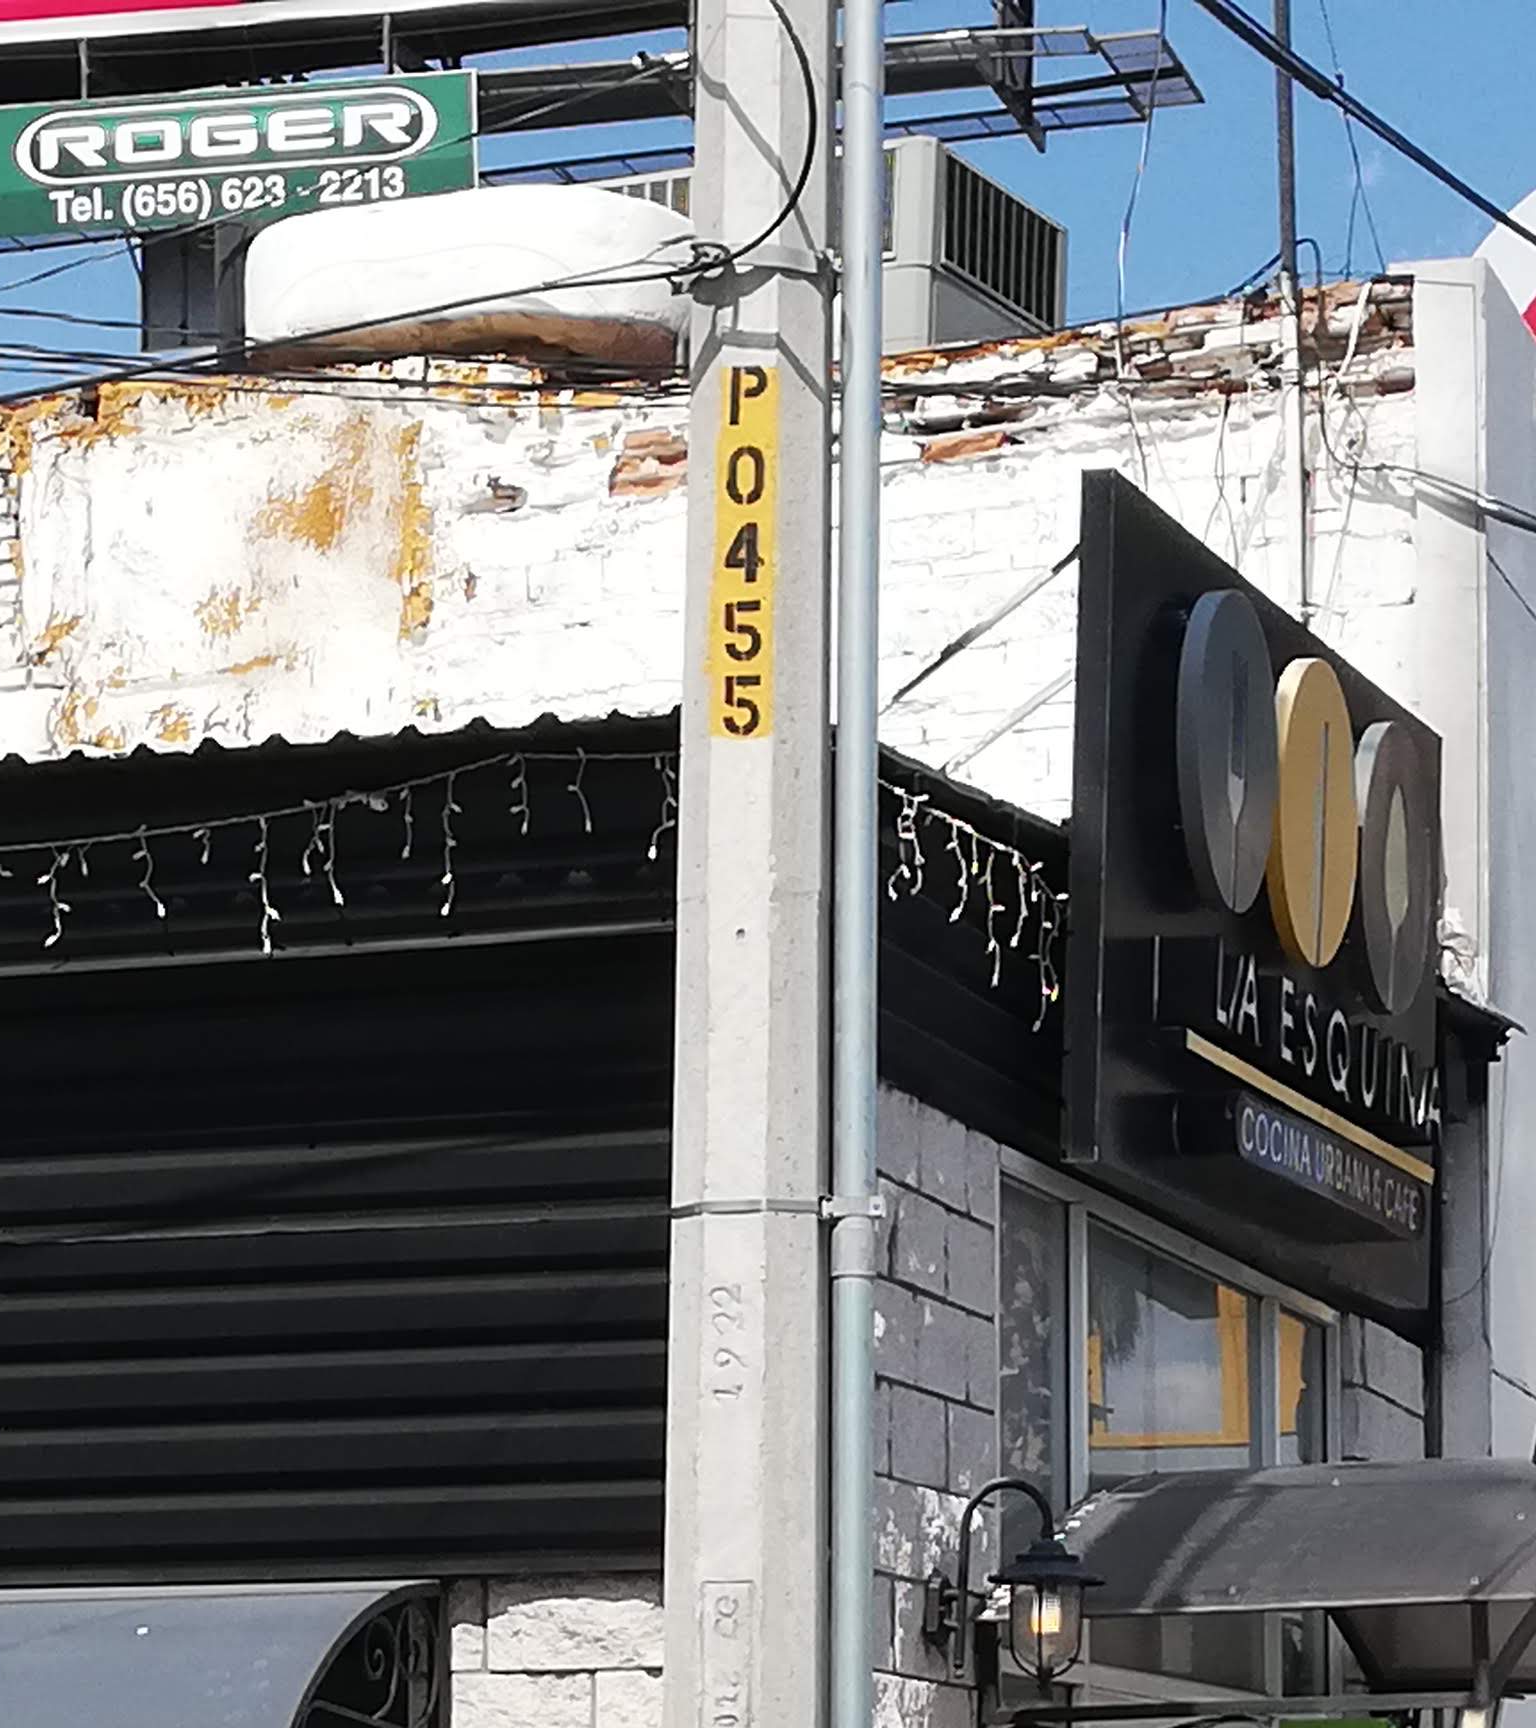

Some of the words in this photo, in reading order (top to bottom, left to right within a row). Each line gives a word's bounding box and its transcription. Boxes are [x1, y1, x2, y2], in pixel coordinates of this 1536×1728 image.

[36, 102, 414, 170] ROGER
[47, 187, 113, 224] Tel.
[122, 179, 211, 220] (656)
[221, 174, 286, 210] 623
[318, 166, 405, 202] 2213
[722, 366, 768, 736] P0455
[1216, 936, 1262, 1047] LA
[1280, 977, 1441, 1137] ESQUINA
[1241, 1107, 1311, 1177] COCINA
